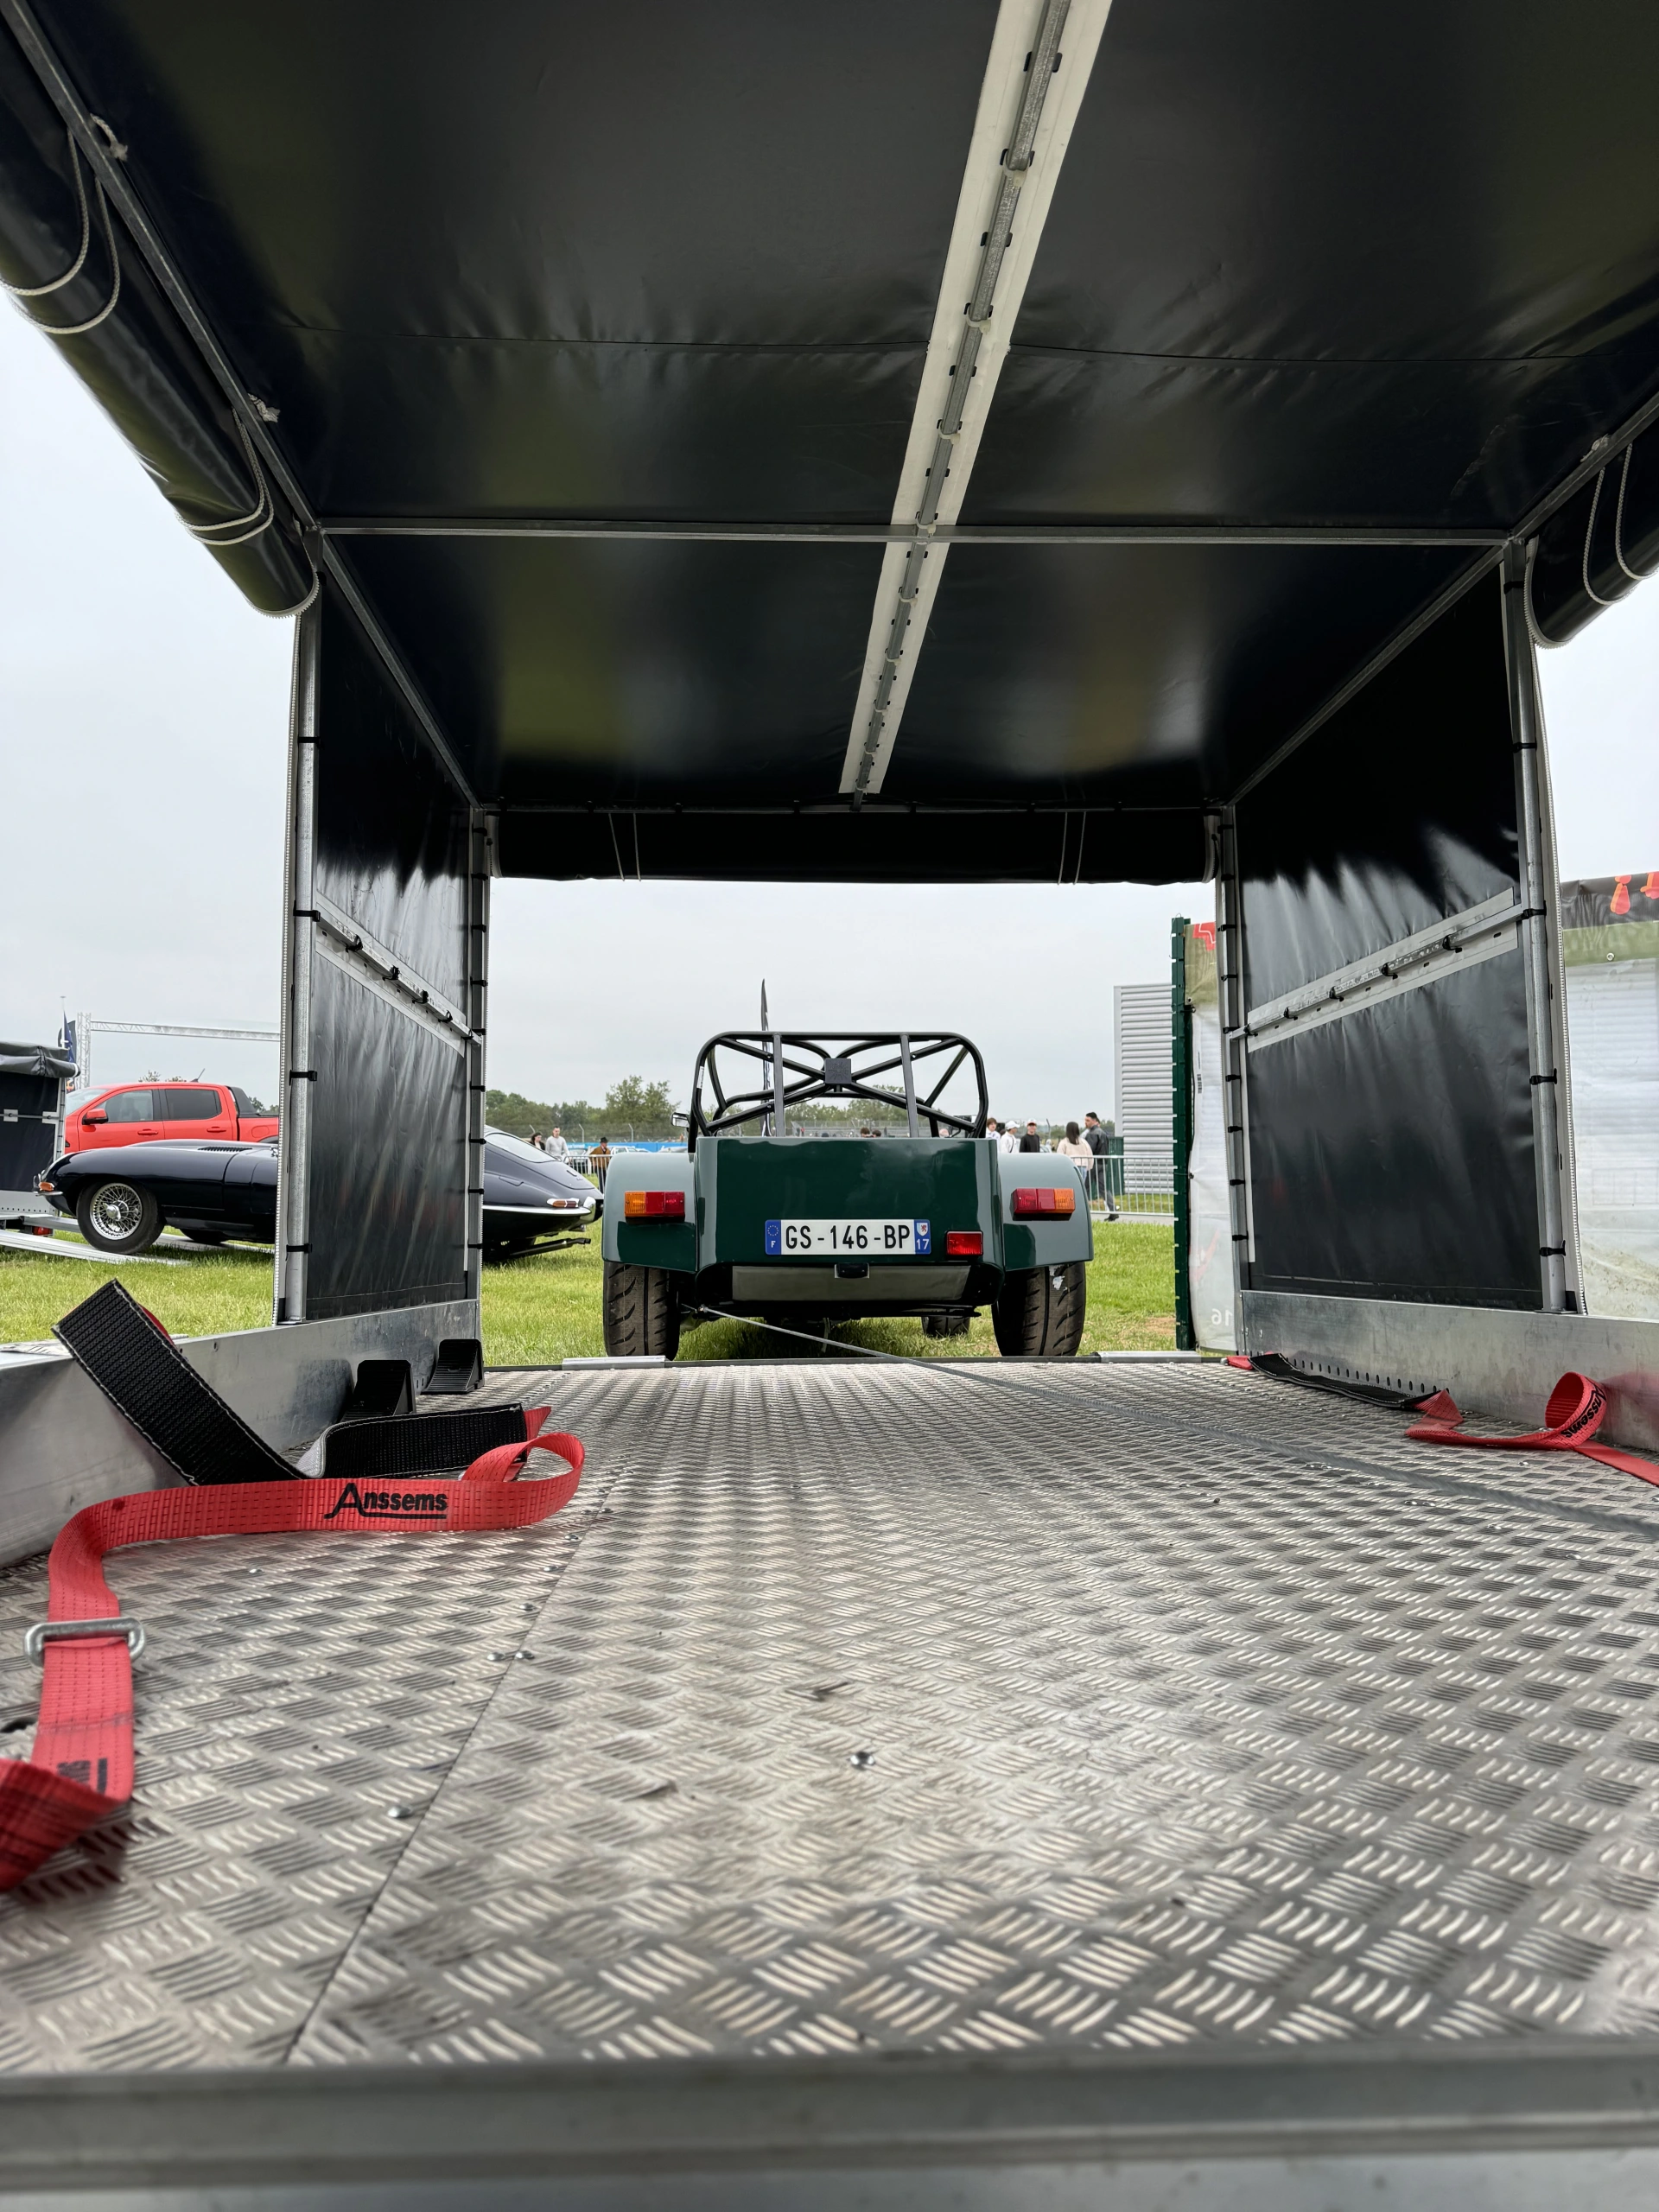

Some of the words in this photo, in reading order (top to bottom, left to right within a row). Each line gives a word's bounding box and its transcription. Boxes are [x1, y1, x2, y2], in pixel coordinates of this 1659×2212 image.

[771, 1240, 777, 1249] F
[785, 1224, 911, 1249] GS-146-BP
[916, 1238, 930, 1250] 17
[1560, 1376, 1607, 1438] Anssems
[324, 1482, 448, 1519] Anssems
